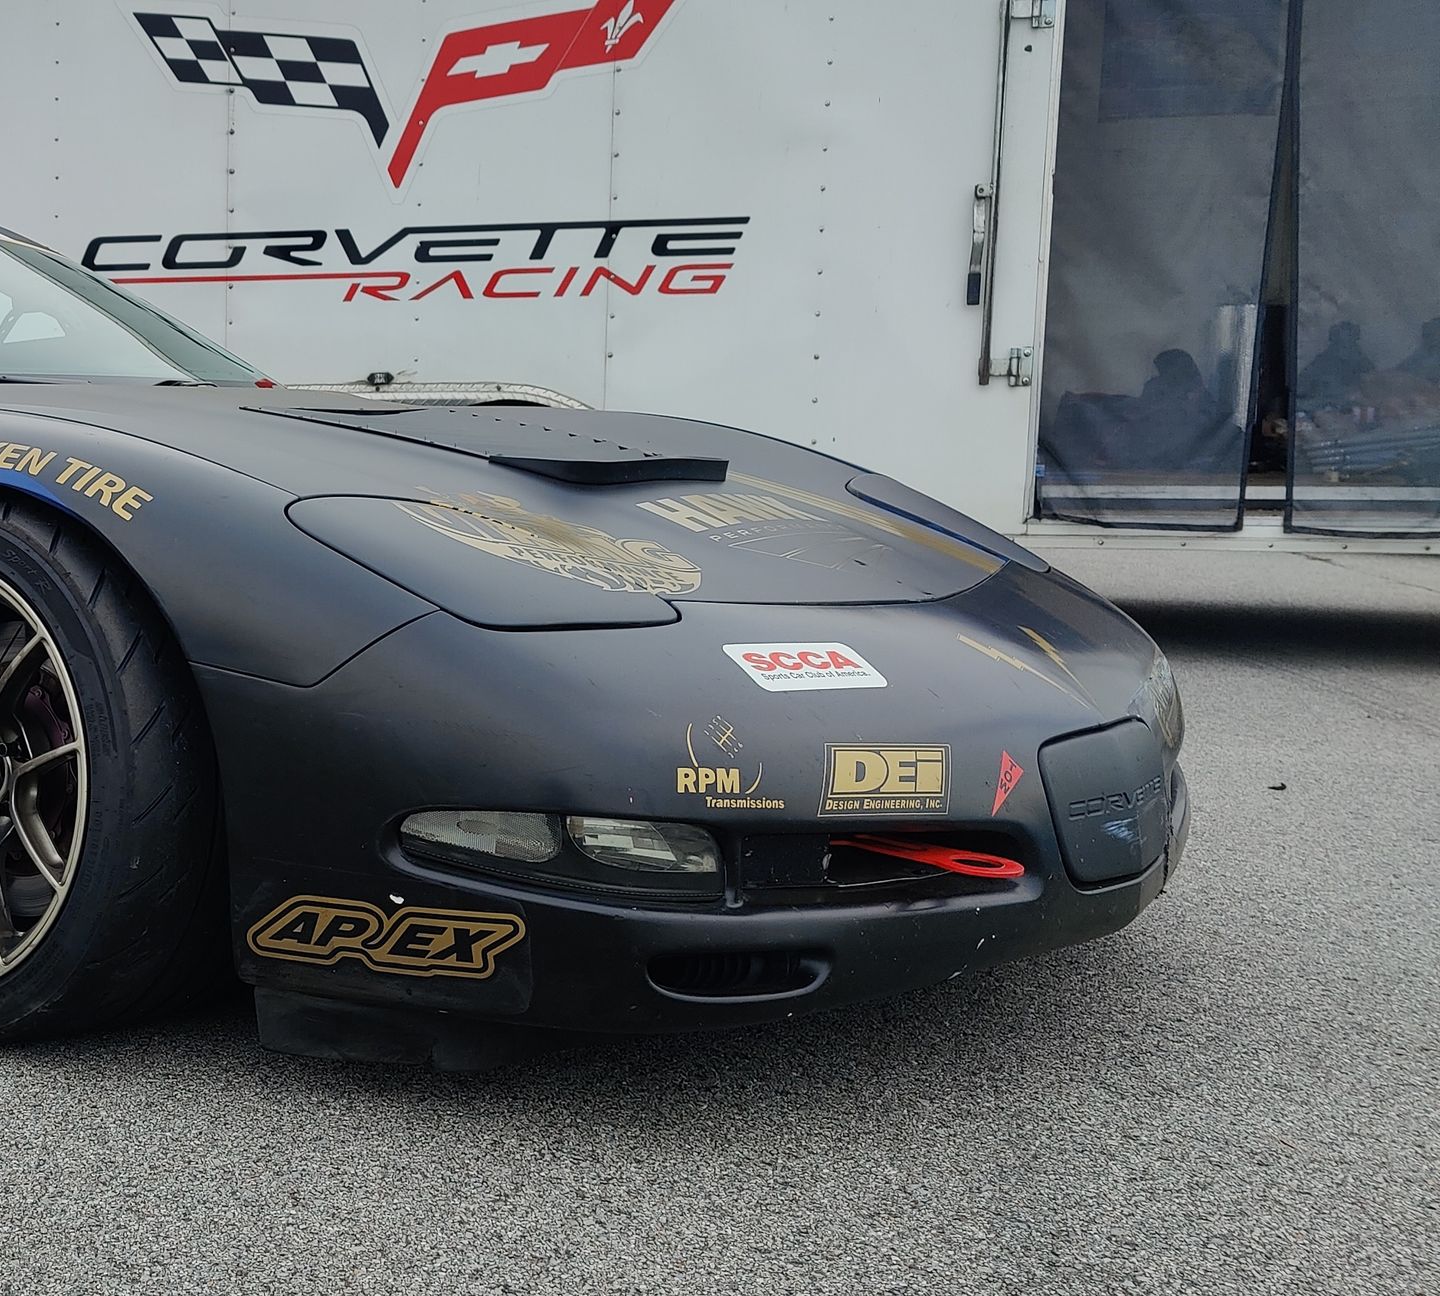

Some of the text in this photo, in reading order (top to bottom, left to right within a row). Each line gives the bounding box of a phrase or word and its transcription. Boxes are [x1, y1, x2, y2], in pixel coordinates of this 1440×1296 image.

[81, 215, 750, 272] CORVETTE
[342, 262, 734, 302] RACING
[55, 457, 154, 522] TIRE
[741, 650, 863, 672] SCCA
[761, 673, 790, 681] Sports
[805, 671, 825, 679] Club
[677, 767, 741, 794] RPM
[1000, 759, 1017, 795] TOW
[705, 796, 785, 809] Transmissions
[267, 910, 498, 964] APEX
